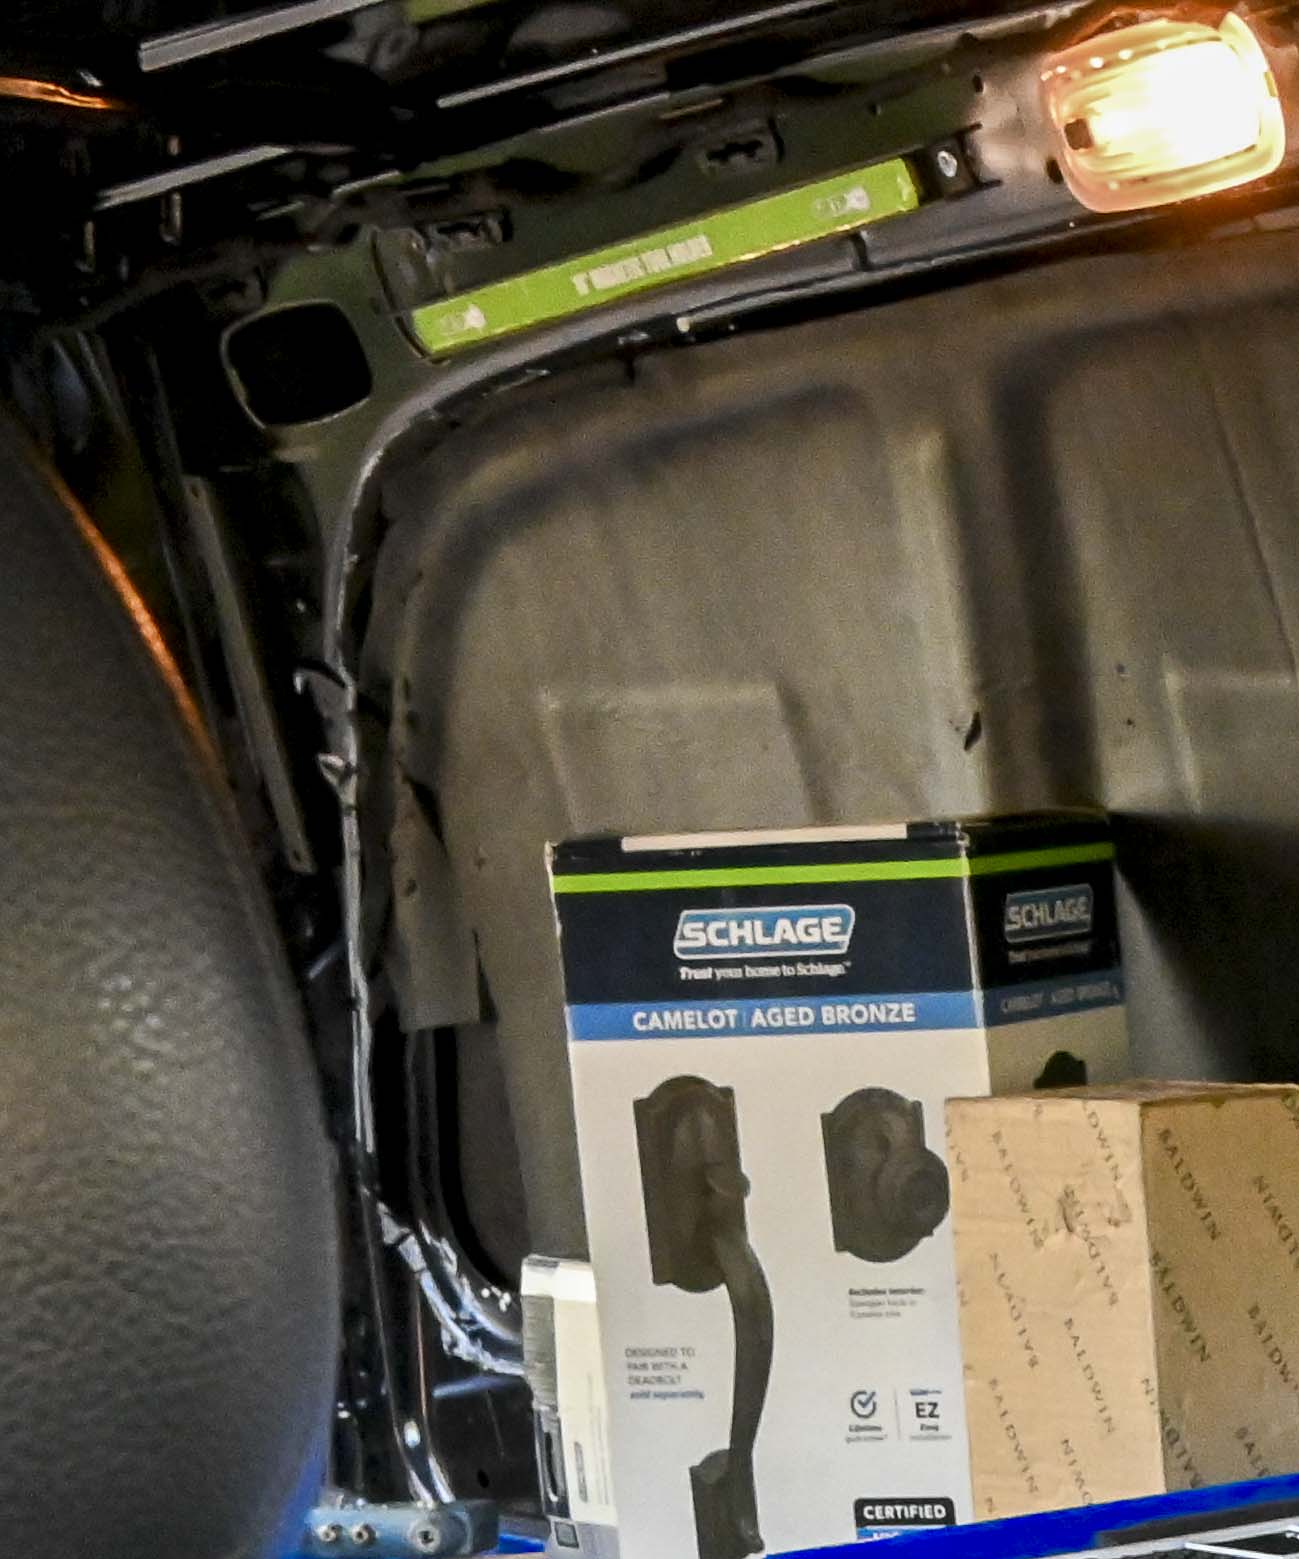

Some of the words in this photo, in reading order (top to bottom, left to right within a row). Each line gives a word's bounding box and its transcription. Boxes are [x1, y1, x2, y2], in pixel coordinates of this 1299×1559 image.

[679, 916, 844, 948] SCHLAGE
[633, 1012, 737, 1031] CAMELOT
[751, 1006, 814, 1028] AGED
[822, 1003, 916, 1025] BRONZE
[993, 1129, 1045, 1250] BALDWIN
[1158, 1128, 1222, 1242] BALDWIN
[1152, 1250, 1212, 1364] BALDWIN
[680, 1347, 696, 1357] TO
[1065, 1316, 1116, 1436] BALDWIN
[915, 1402, 940, 1419] EZ
[989, 1377, 1039, 1496] BALDWIN
[863, 1504, 947, 1521] CERTIFIED
